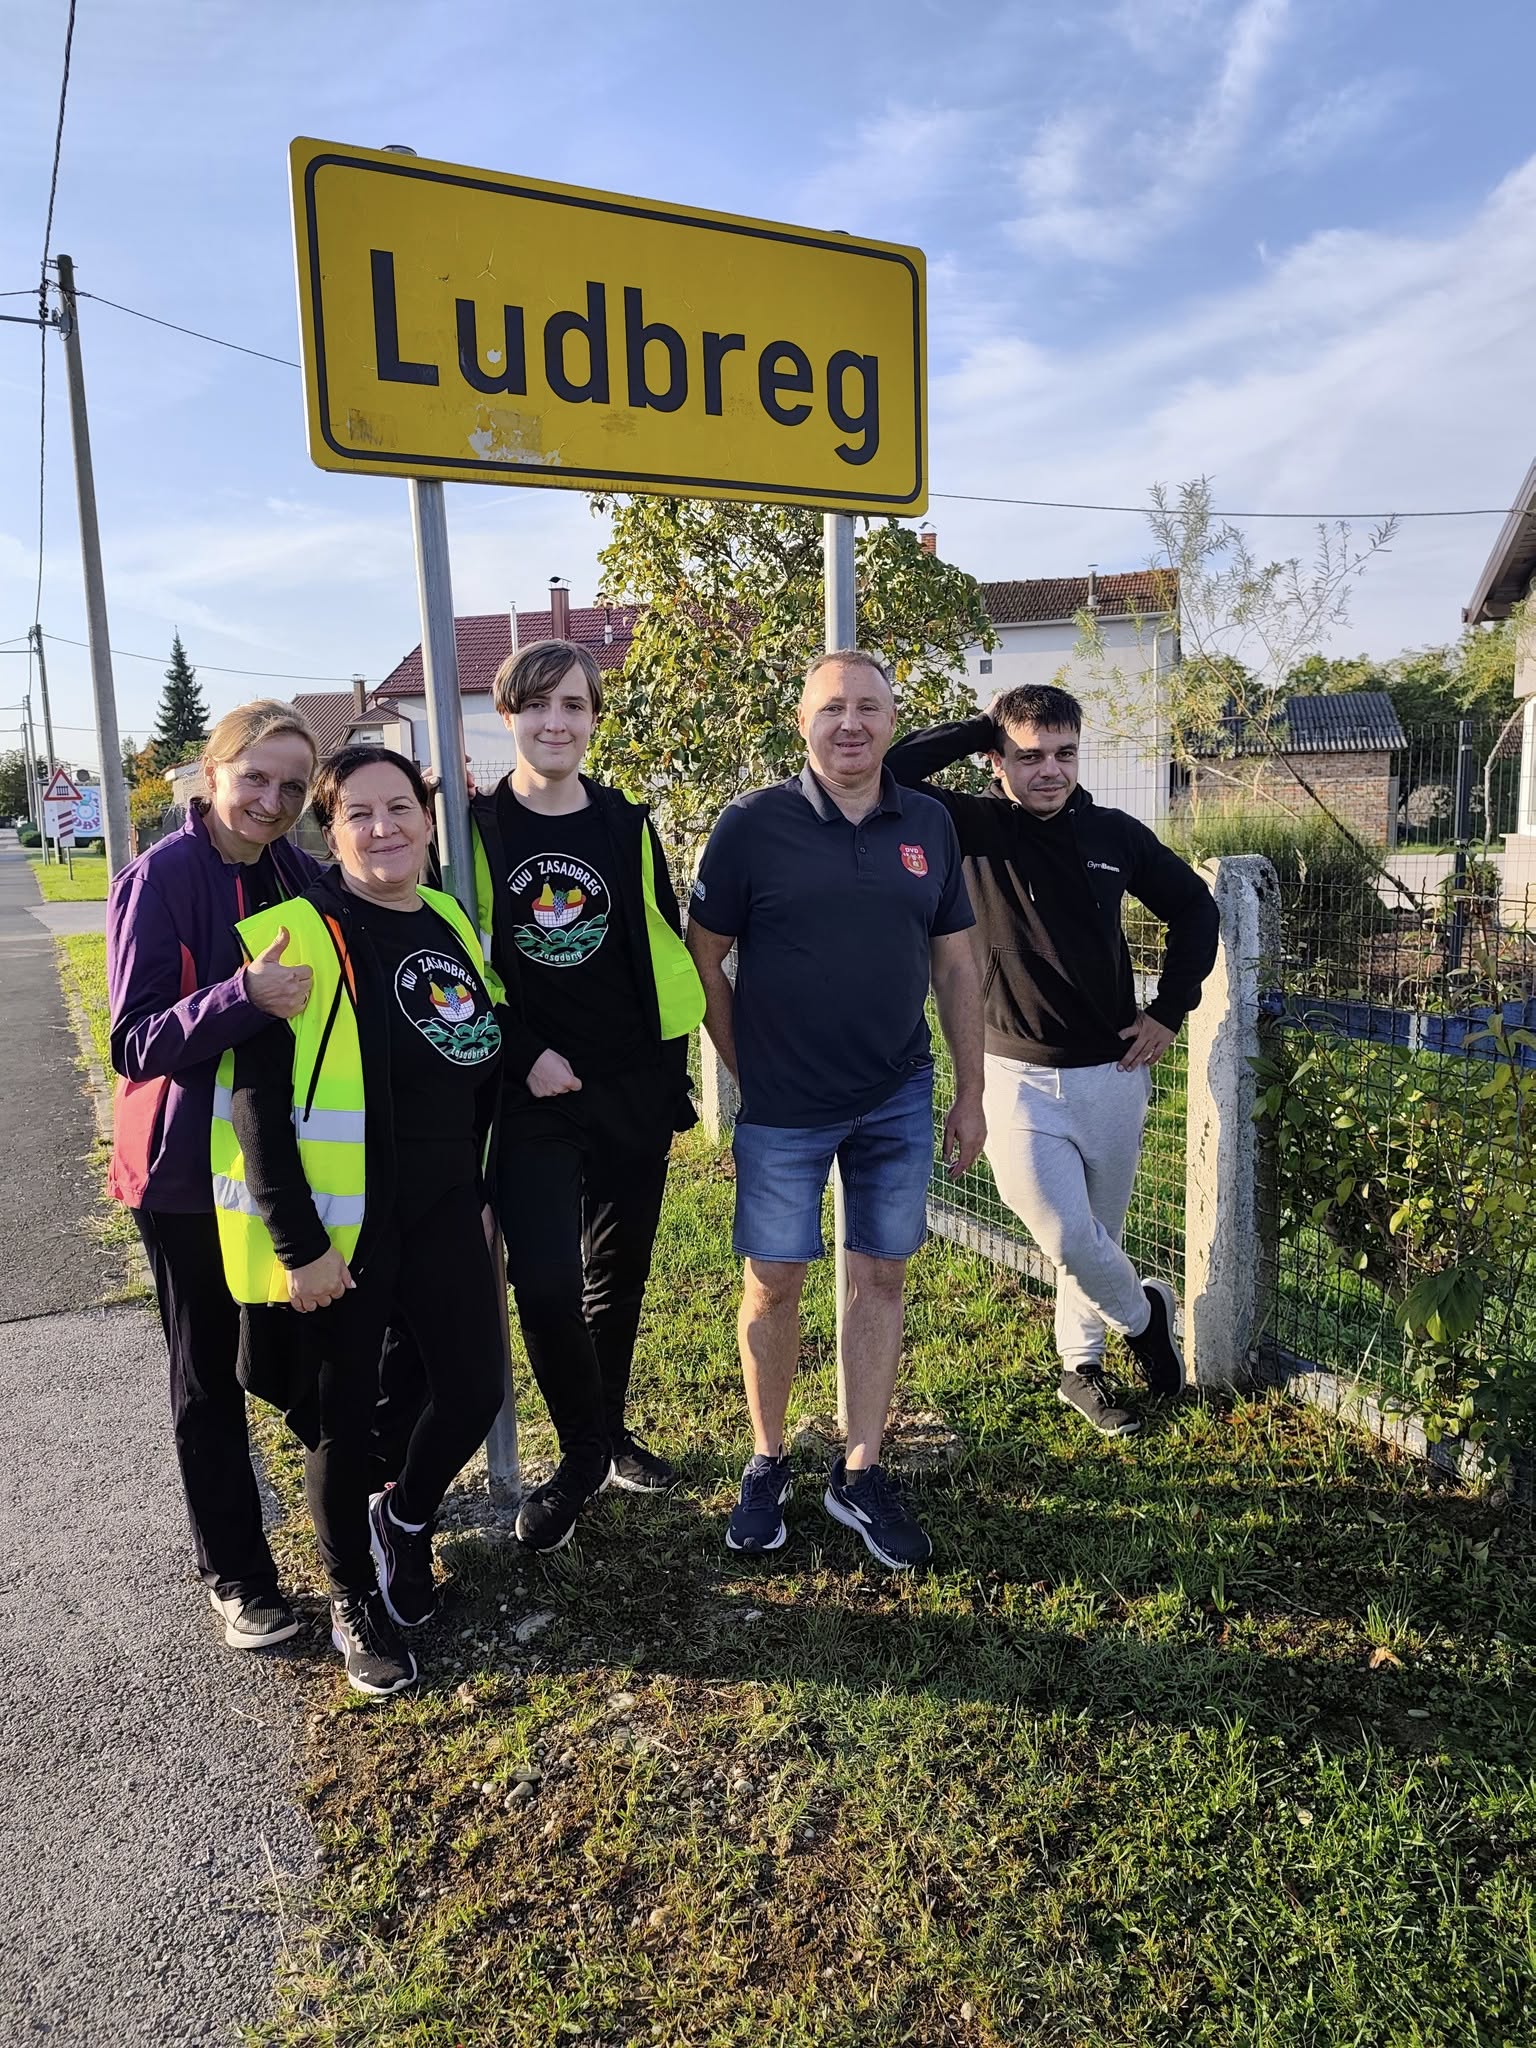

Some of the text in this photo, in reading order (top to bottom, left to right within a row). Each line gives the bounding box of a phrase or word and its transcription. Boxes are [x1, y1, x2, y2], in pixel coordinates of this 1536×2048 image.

[370, 249, 879, 465] Ludbreg
[509, 860, 602, 896] KUU ZASADBREG
[418, 956, 477, 991] ZASADBREG
